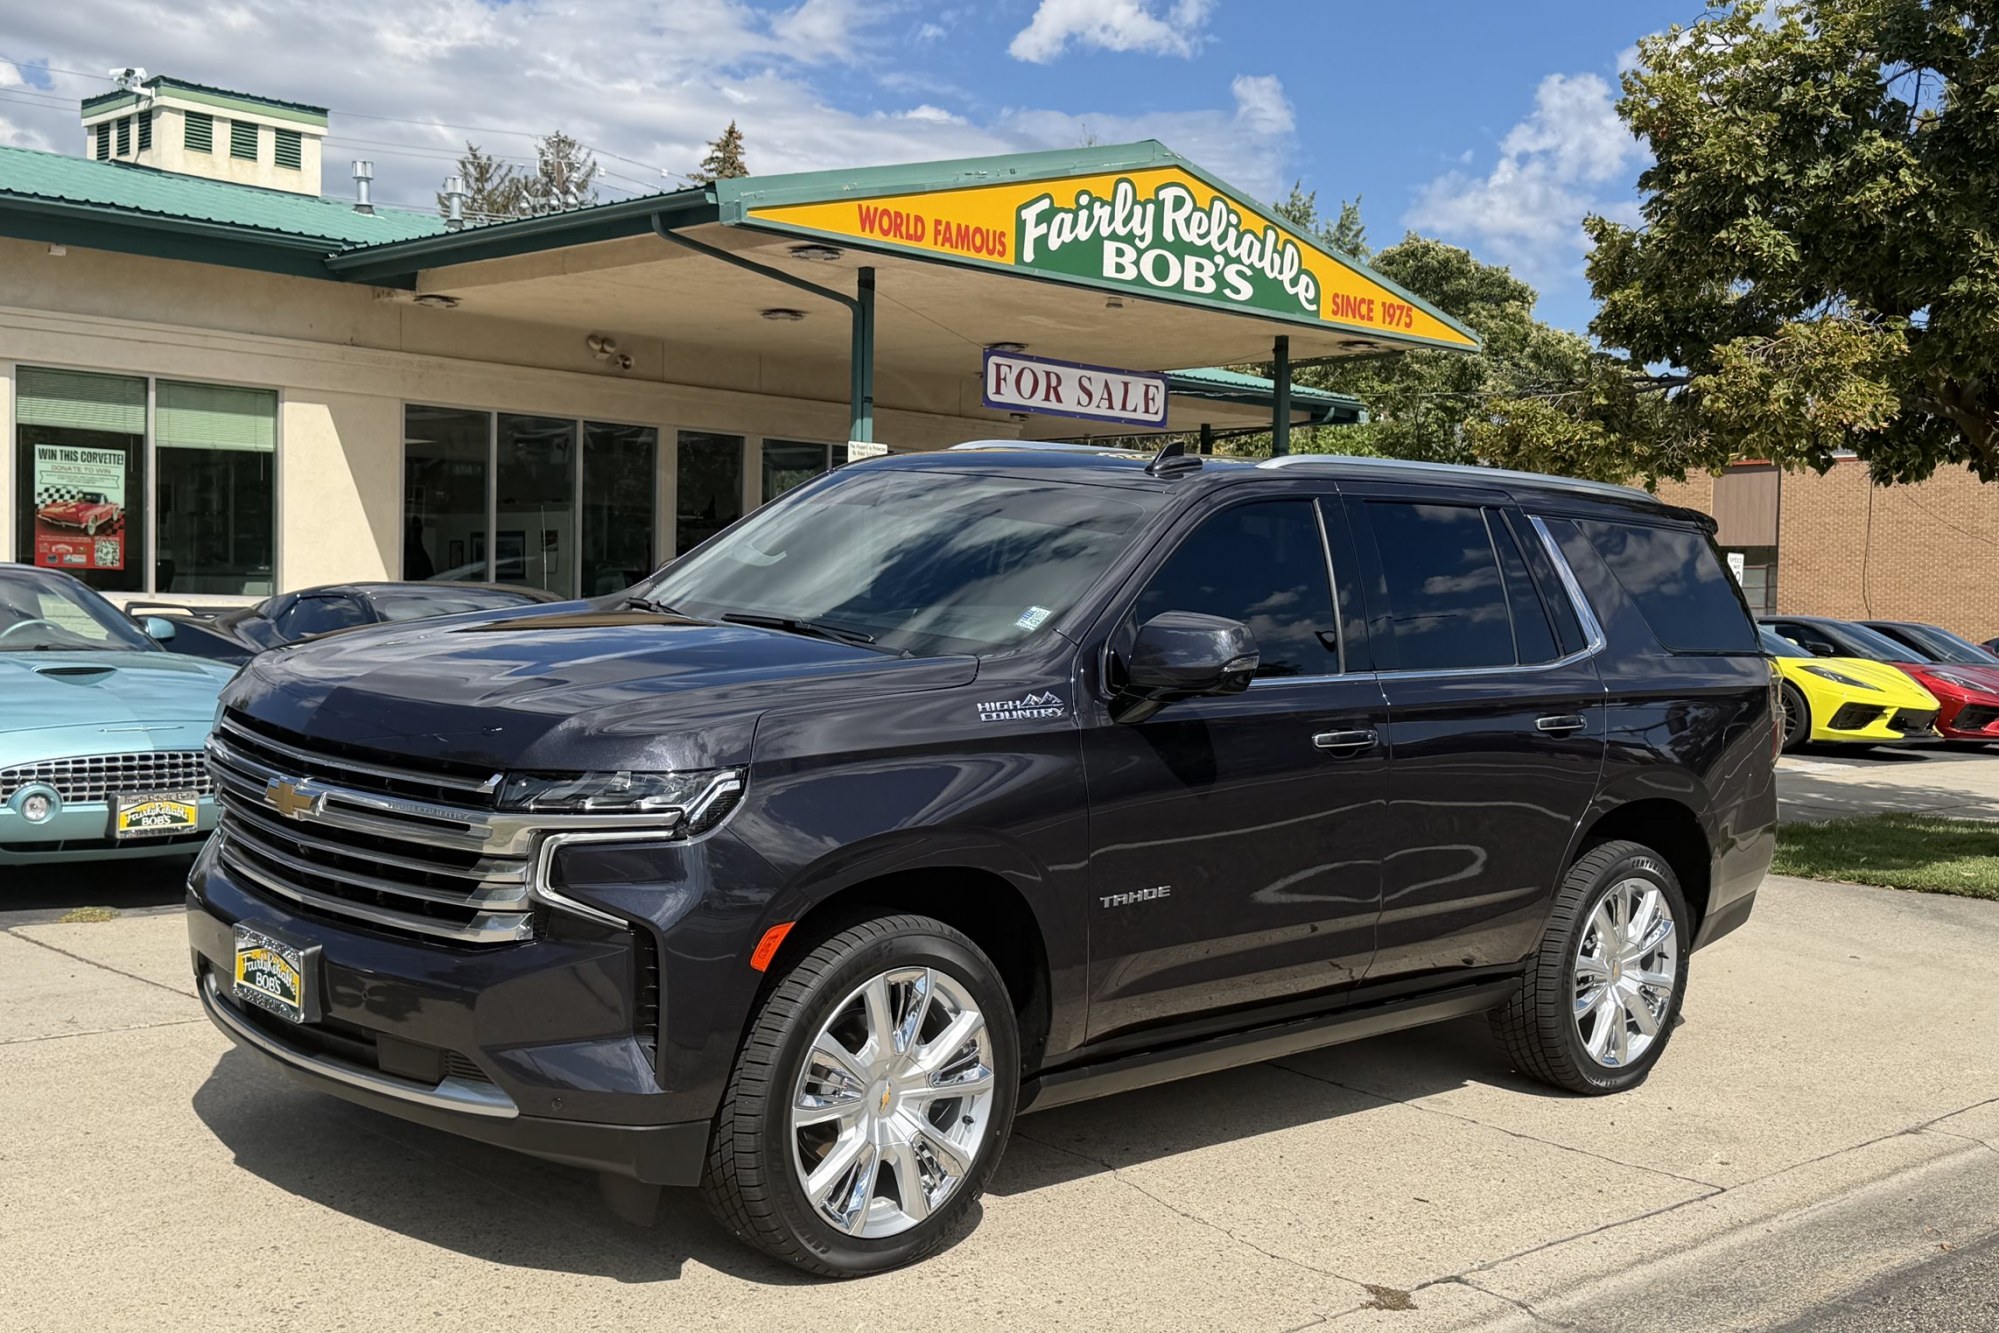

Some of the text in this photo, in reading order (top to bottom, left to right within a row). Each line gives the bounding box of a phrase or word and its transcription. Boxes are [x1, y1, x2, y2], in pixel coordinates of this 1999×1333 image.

[857, 203, 1007, 258] WORLD FAMOUS
[1021, 182, 1318, 311] Fairly Reliable
[1102, 241, 1254, 301] BOB'S
[1332, 293, 1413, 329] SINCE 1975
[992, 362, 1161, 415] FOR SALE
[38, 448, 124, 465] WIN THIS CORVETTE!
[51, 465, 82, 473] DONATE
[977, 700, 1021, 712] HIGH
[980, 707, 1065, 721] COUNTRY
[141, 814, 172, 826] BOB'S
[1099, 885, 1171, 908] TAHOE
[242, 953, 268, 974] Fairly
[255, 972, 282, 994] BOB'S
